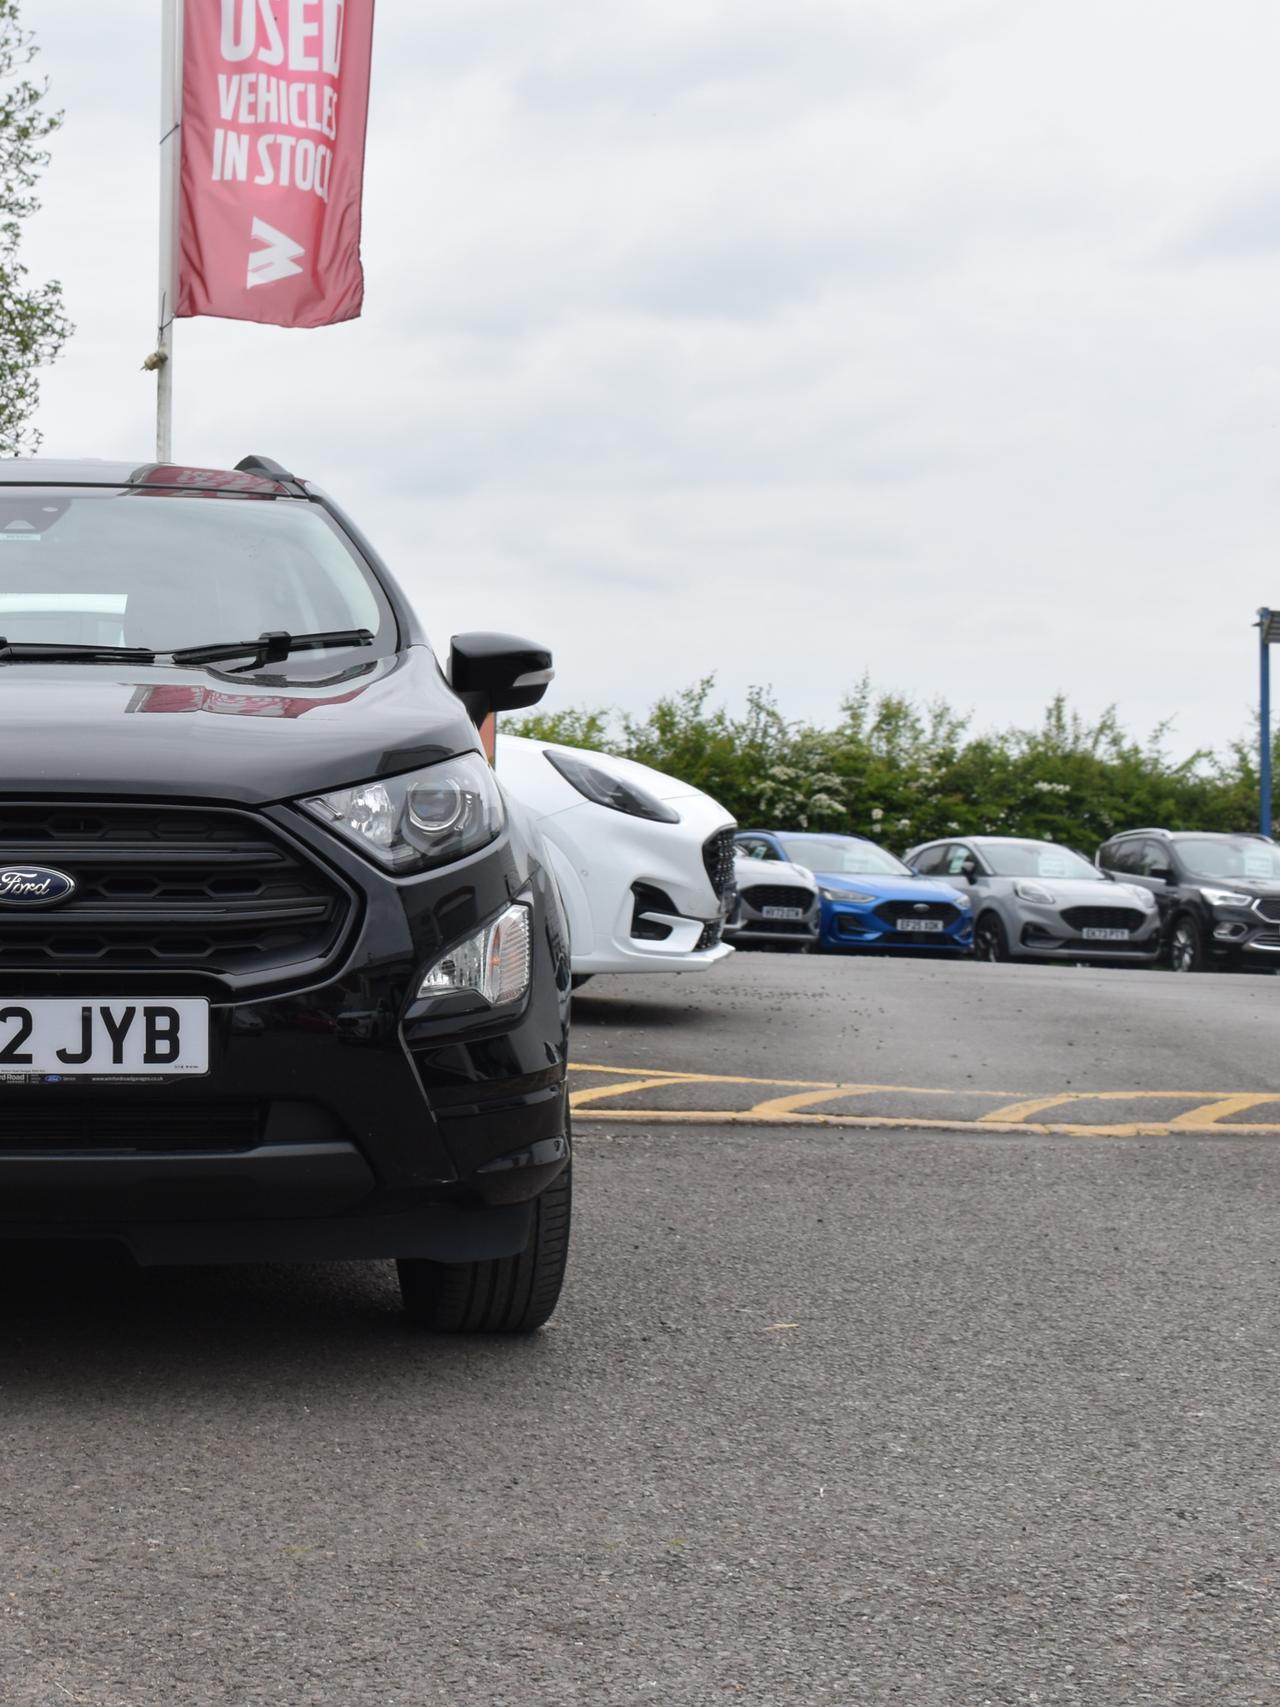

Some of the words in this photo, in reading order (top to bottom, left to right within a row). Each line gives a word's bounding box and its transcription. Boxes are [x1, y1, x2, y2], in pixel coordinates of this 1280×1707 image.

[221, 0, 343, 78] USED
[212, 128, 249, 181] IN
[254, 134, 333, 203] STOC
[56, 1007, 180, 1064] JYB
